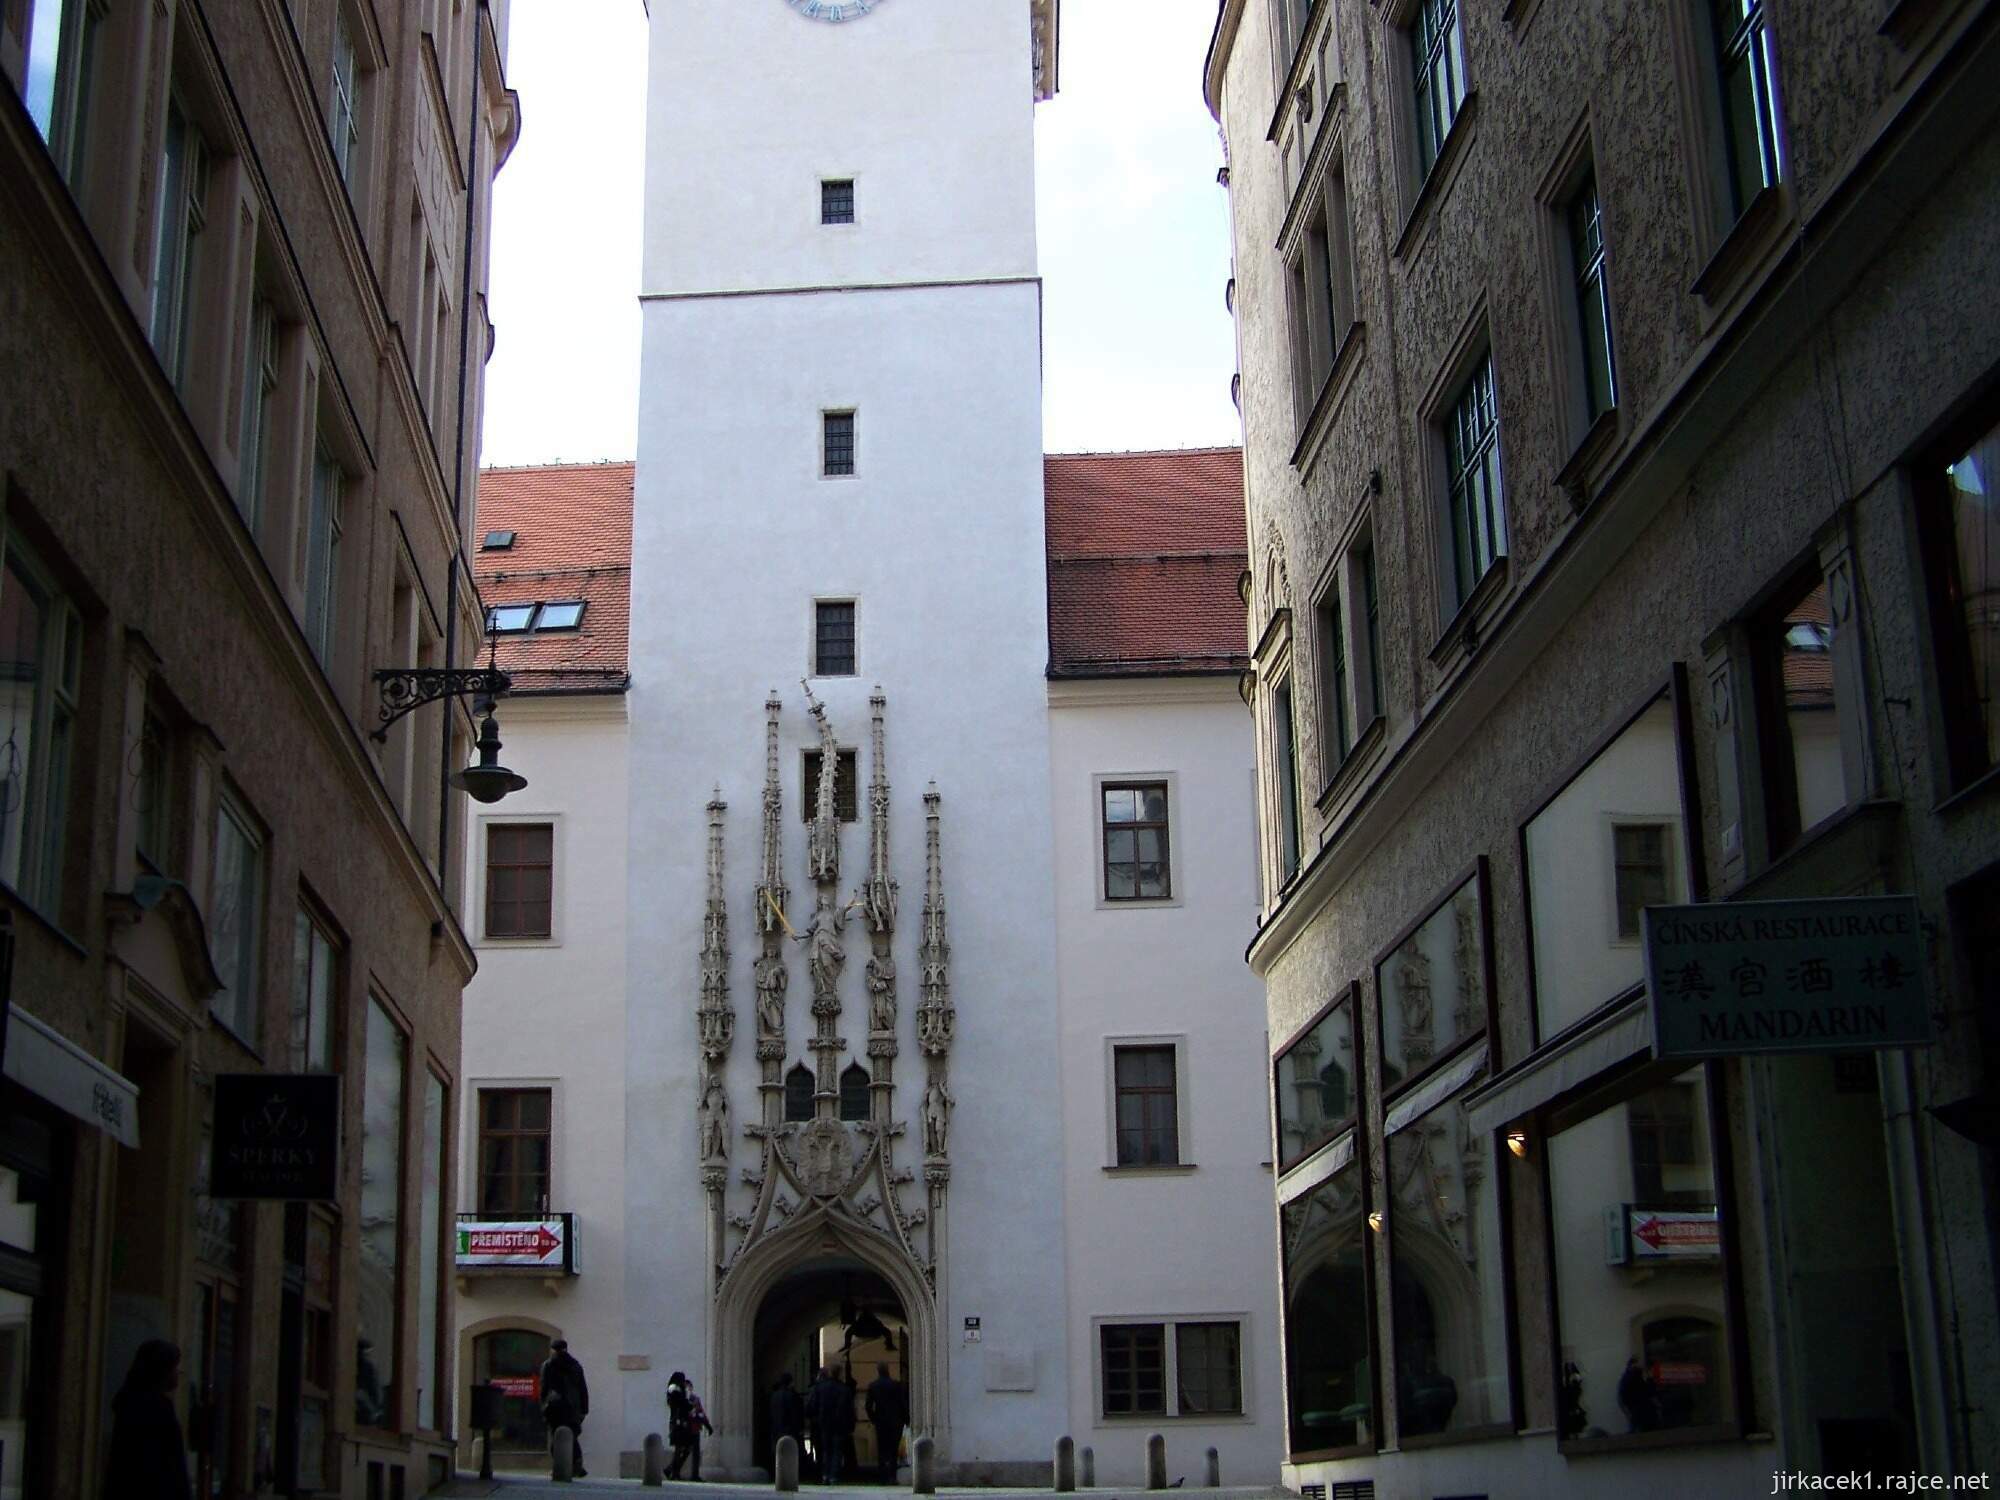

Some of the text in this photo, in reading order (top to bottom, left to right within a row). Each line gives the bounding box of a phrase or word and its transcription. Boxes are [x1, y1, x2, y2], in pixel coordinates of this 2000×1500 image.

[1657, 912, 1912, 945] ČÍNSKÁ RESTAURACE
[1700, 1004, 1888, 1042] MANDARIN
